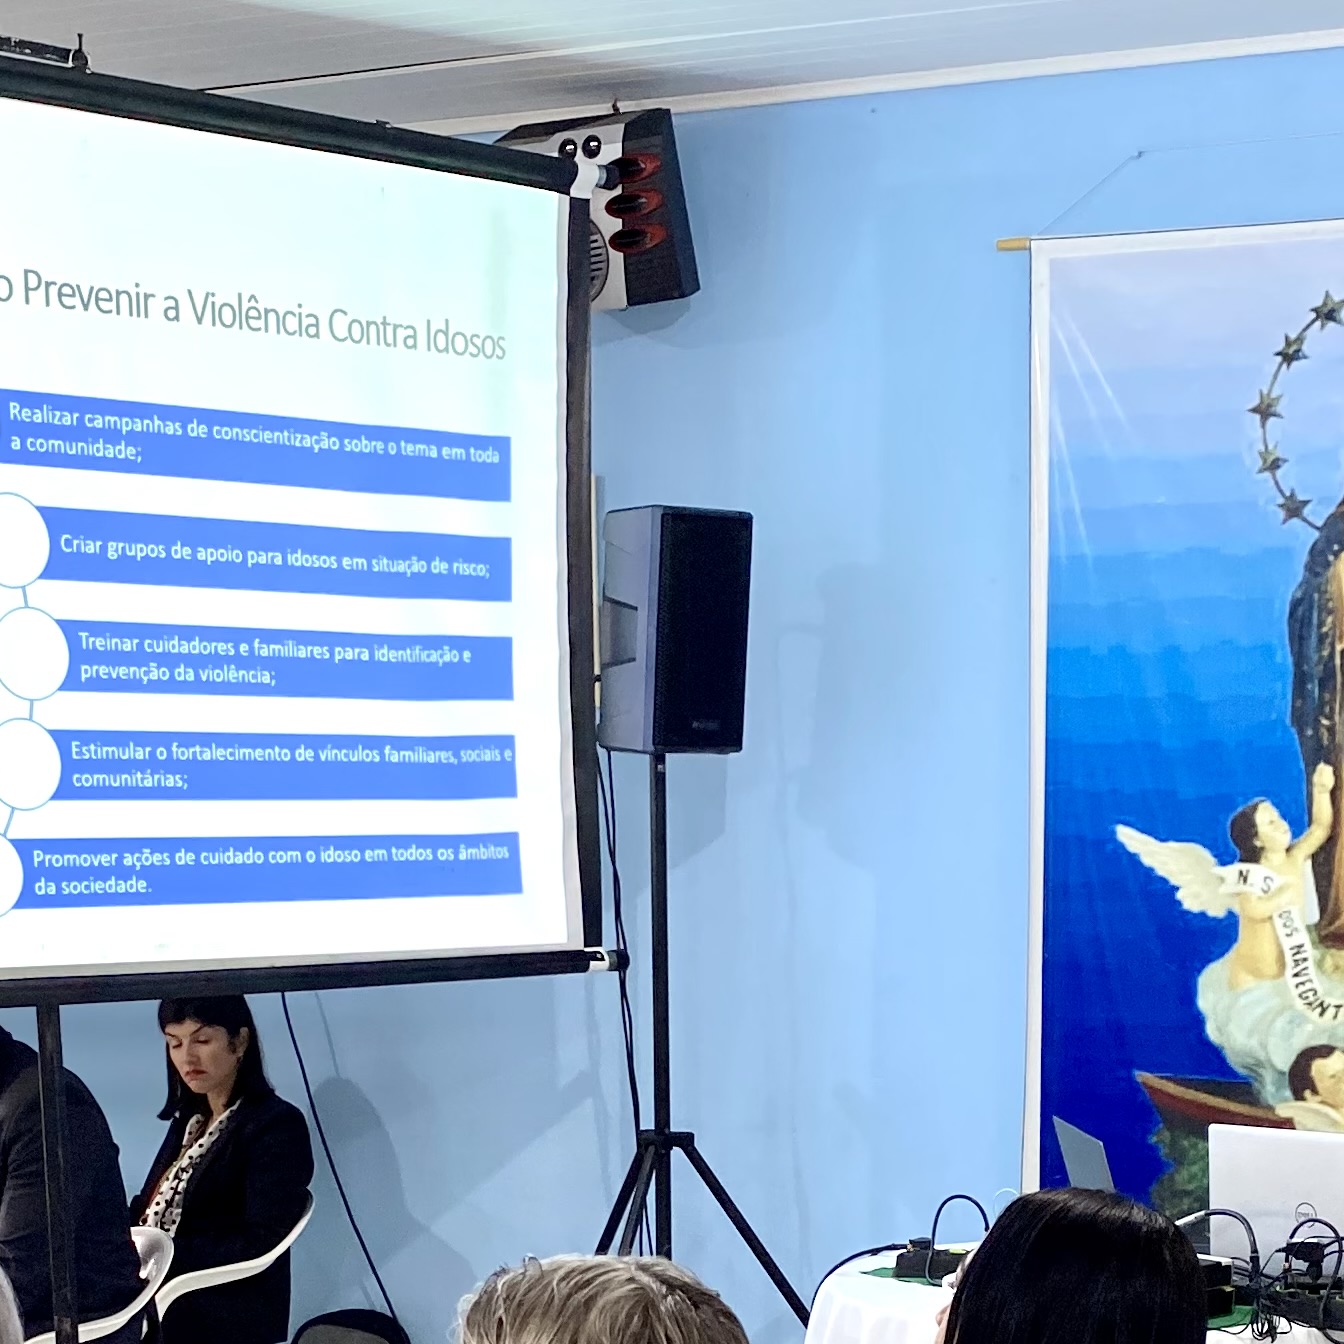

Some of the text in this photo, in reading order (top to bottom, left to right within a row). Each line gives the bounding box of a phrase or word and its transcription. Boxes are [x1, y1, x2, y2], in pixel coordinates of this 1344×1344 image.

[23, 268, 157, 320] Prevenir
[163, 295, 181, 323] a
[186, 288, 321, 340] Violência
[328, 308, 418, 351] Contra
[426, 318, 506, 361] Idosos
[9, 401, 500, 464] Realizar campanhas de conscientização sobre o tema em toda
[10, 435, 142, 464] a comunidade;
[60, 533, 490, 579] Criar grupos de apoio para idosos em situação de risco;
[79, 631, 472, 667] Treinar cuidadores e familiares para identificação e
[80, 662, 276, 687] prevenção da violência;
[71, 740, 513, 765] Estimular o fortalecimento de vínculos familiares, sociais e
[72, 768, 188, 790] comunitárias;
[33, 843, 510, 871] Promover ações de cuidado com o idoso em todos os âmbitos
[34, 874, 152, 896] da sociedade.
